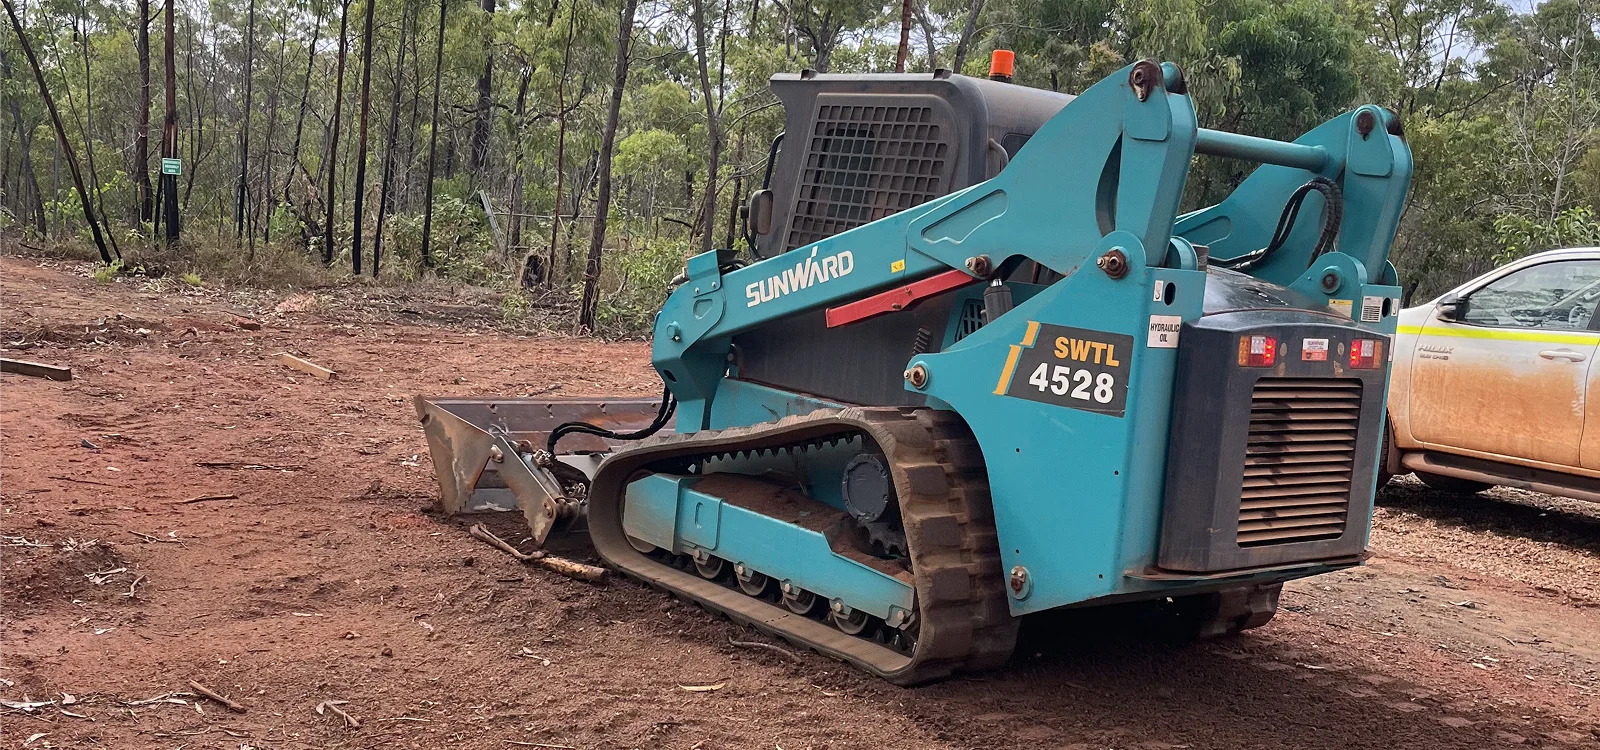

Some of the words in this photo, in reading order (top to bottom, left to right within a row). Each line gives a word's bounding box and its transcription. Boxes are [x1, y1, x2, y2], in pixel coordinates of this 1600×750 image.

[745, 246, 854, 308] SUNWARD
[1150, 323, 1180, 333] HYDRAULIC
[1159, 334, 1168, 343] OIL
[1054, 336, 1120, 367] SWTL
[1029, 362, 1115, 404] 4528
